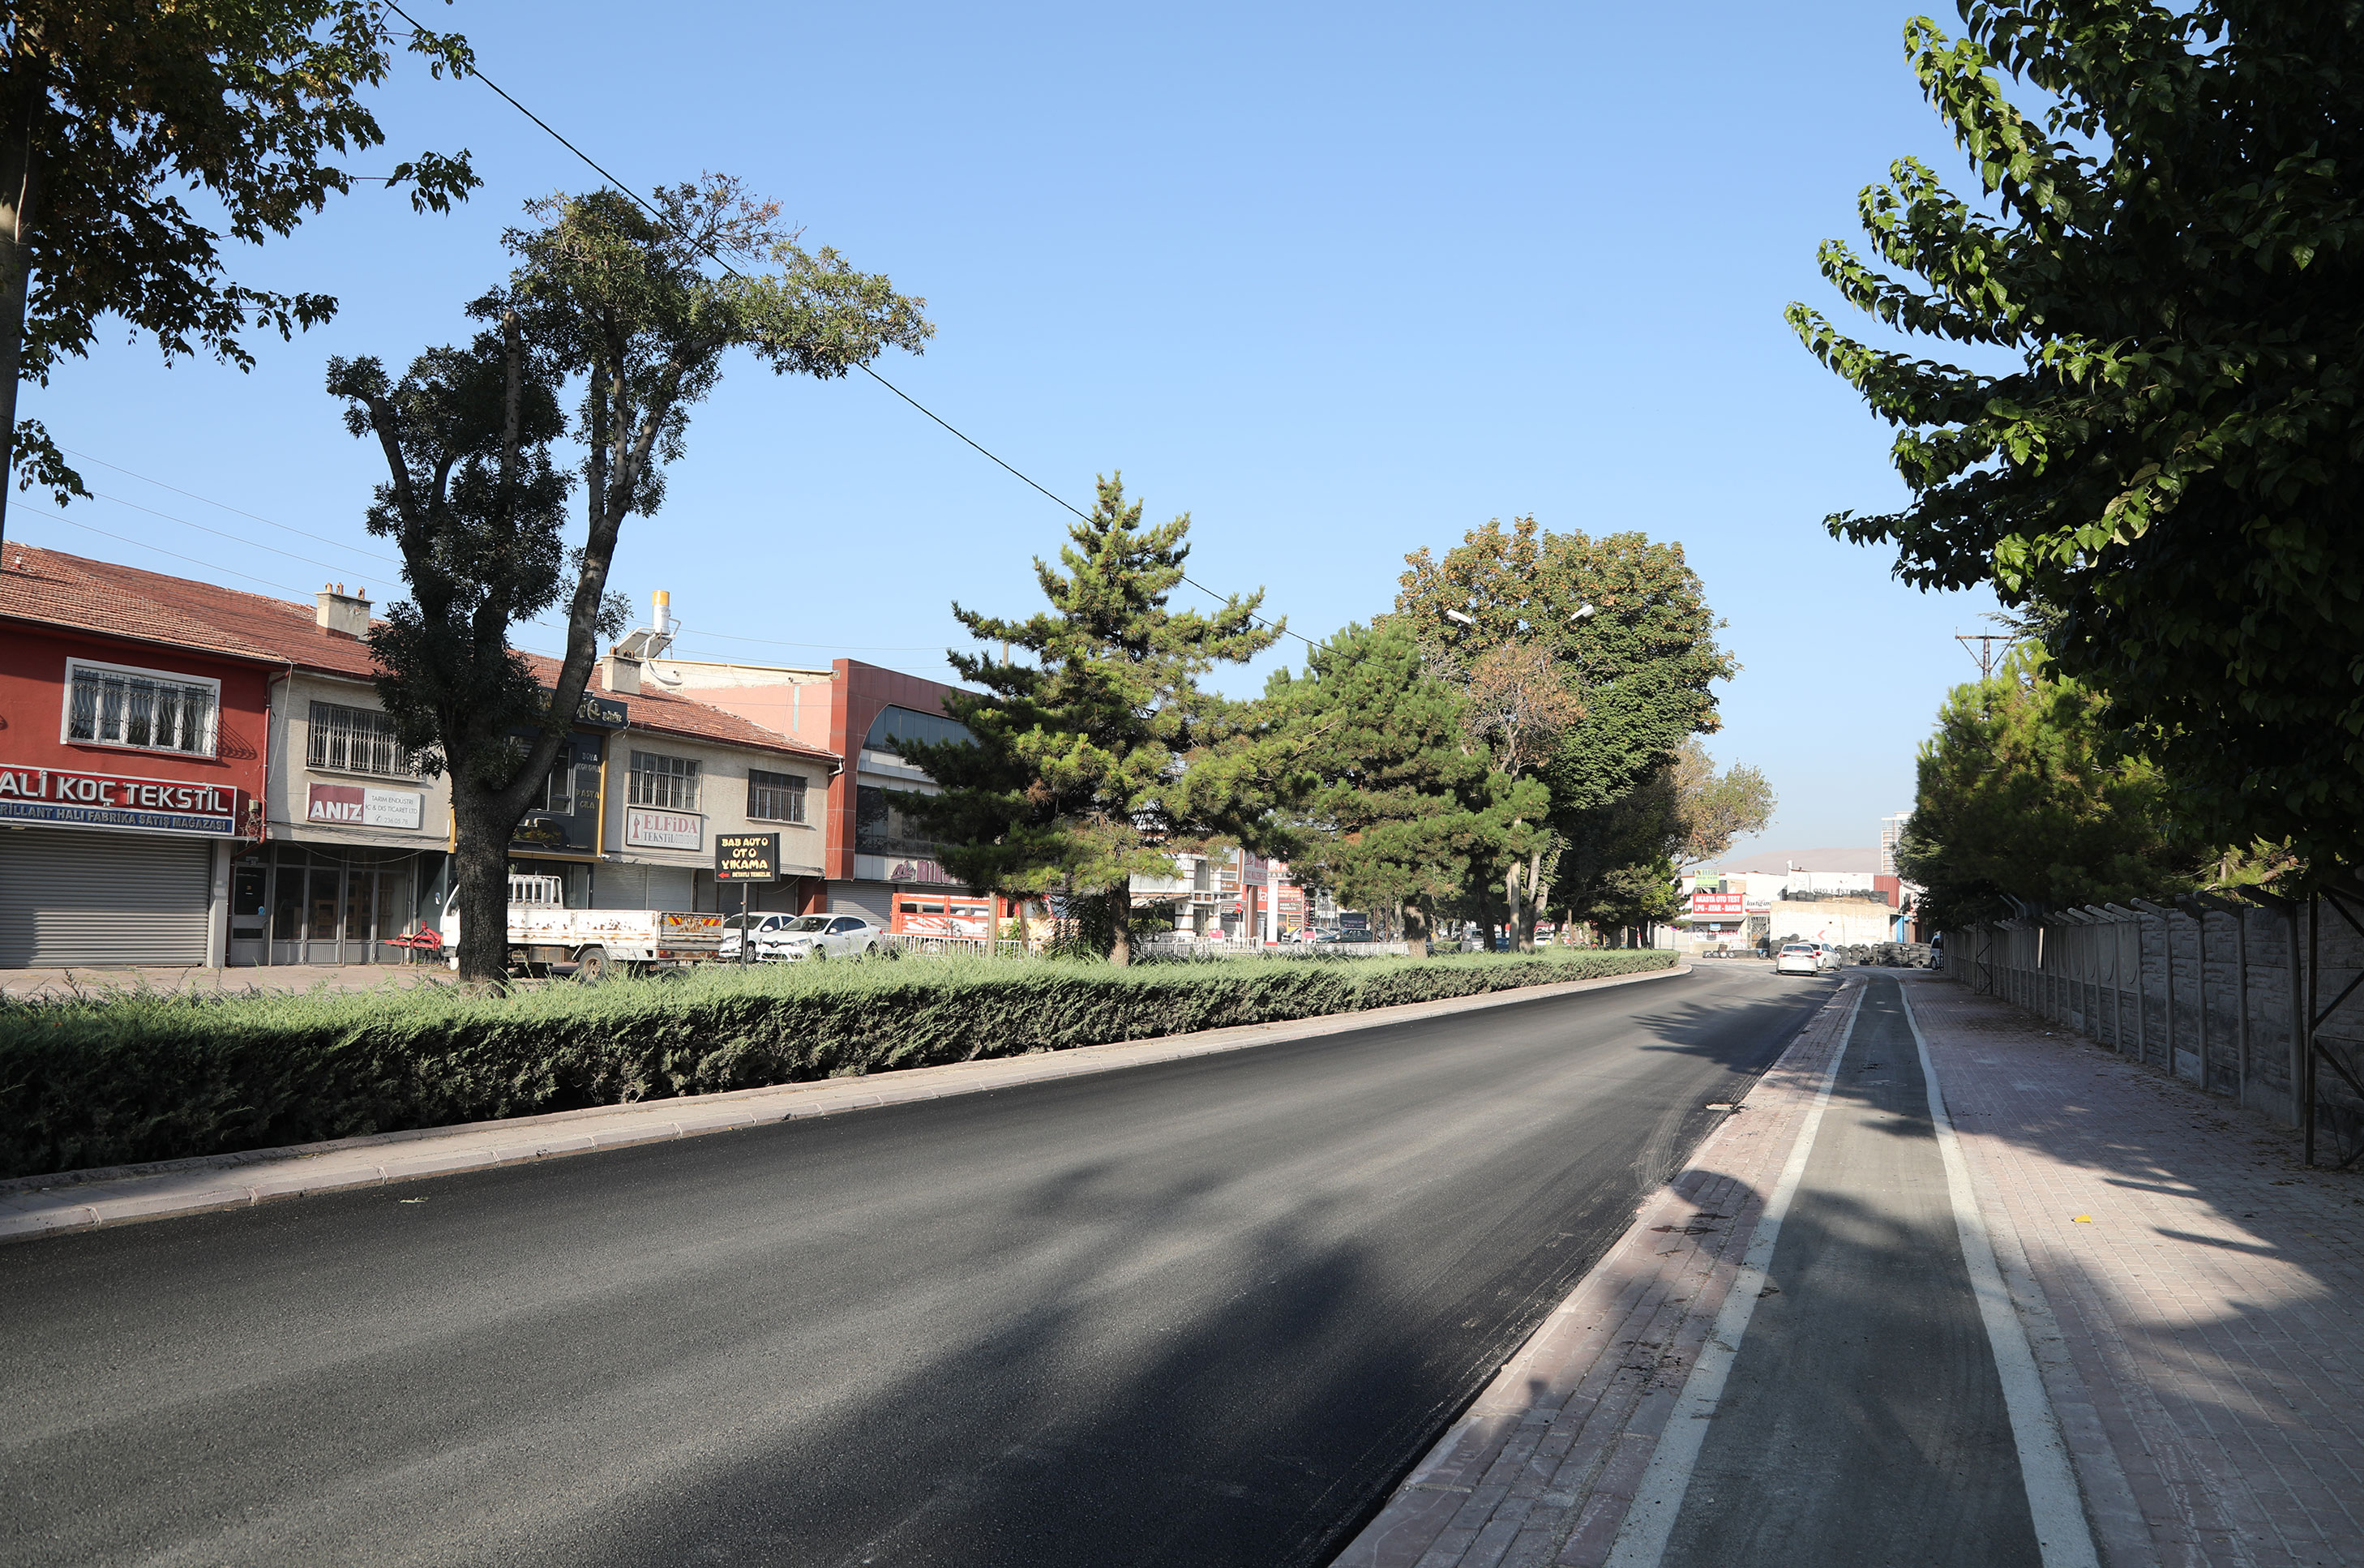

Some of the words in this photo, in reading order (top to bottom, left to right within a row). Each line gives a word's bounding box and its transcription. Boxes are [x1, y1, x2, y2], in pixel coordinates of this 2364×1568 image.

[0, 770, 47, 798] ALİ
[56, 776, 116, 808] KOÇ
[123, 782, 229, 812] TEKSTİL
[310, 800, 362, 821] ANIZ
[56, 809, 84, 820] HALI
[88, 812, 136, 824] FABRİKA
[139, 814, 169, 829] SATIŞ
[722, 838, 742, 847] BAB
[743, 837, 769, 846] AUTO
[732, 847, 757, 859] OTO
[721, 859, 769, 870] YIKAMA
[1695, 895, 1715, 903] AKASYA
[1716, 895, 1727, 903] OTO
[1727, 895, 1741, 903] TEST
[1694, 904, 1705, 912] LPG
[1708, 904, 1722, 912] AYAR
[1724, 904, 1741, 912] BAKIM
